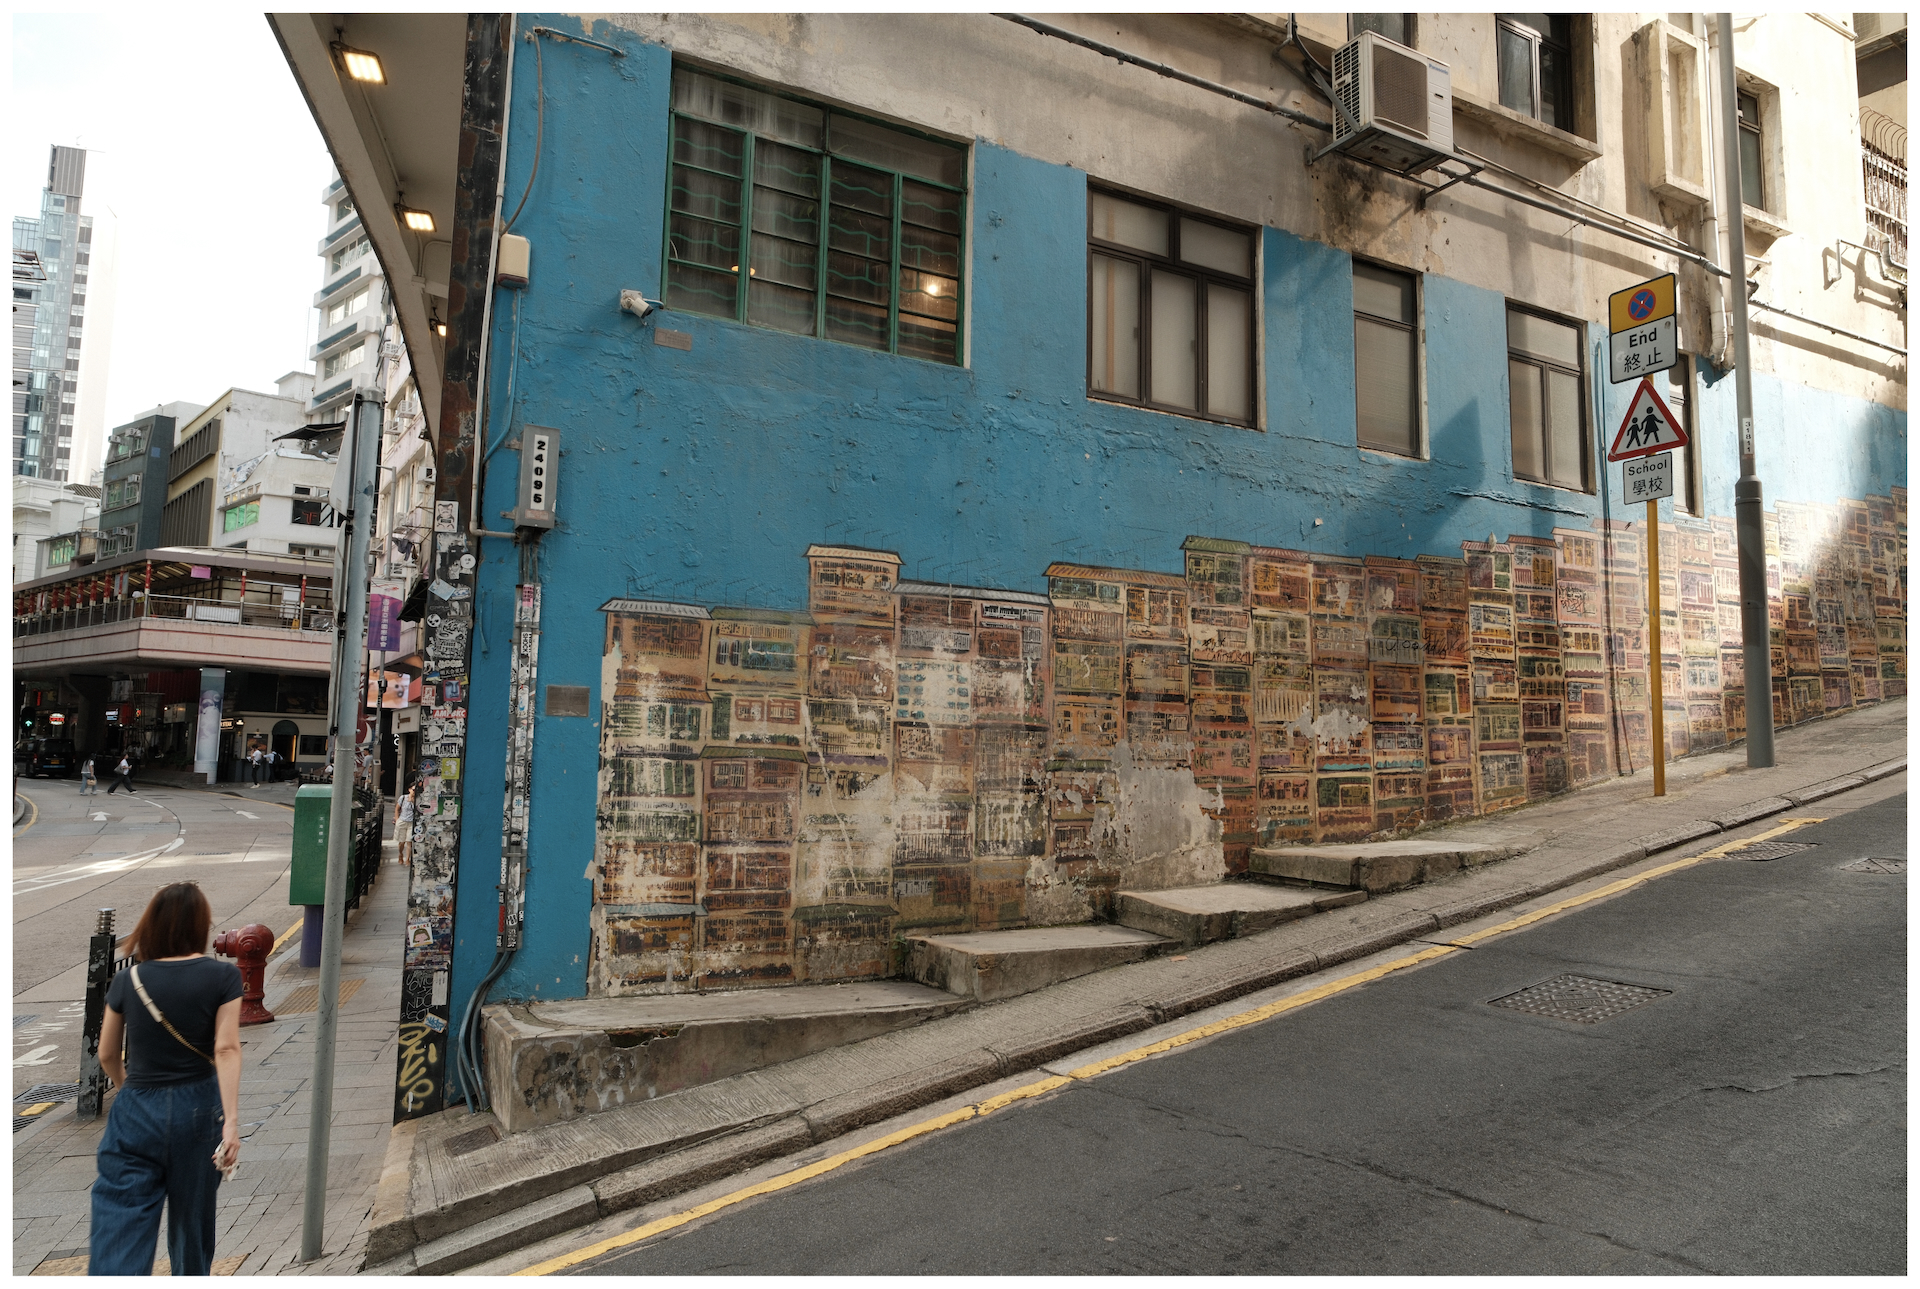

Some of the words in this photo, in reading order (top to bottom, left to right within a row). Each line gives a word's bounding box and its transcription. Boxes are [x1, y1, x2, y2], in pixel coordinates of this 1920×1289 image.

[1429, 64, 1449, 75] Panasonic
[1629, 328, 1657, 347] End
[1624, 347, 1663, 373] 終止
[533, 440, 546, 504] 24095
[1628, 459, 1668, 476] School
[1632, 475, 1663, 496] 學校
